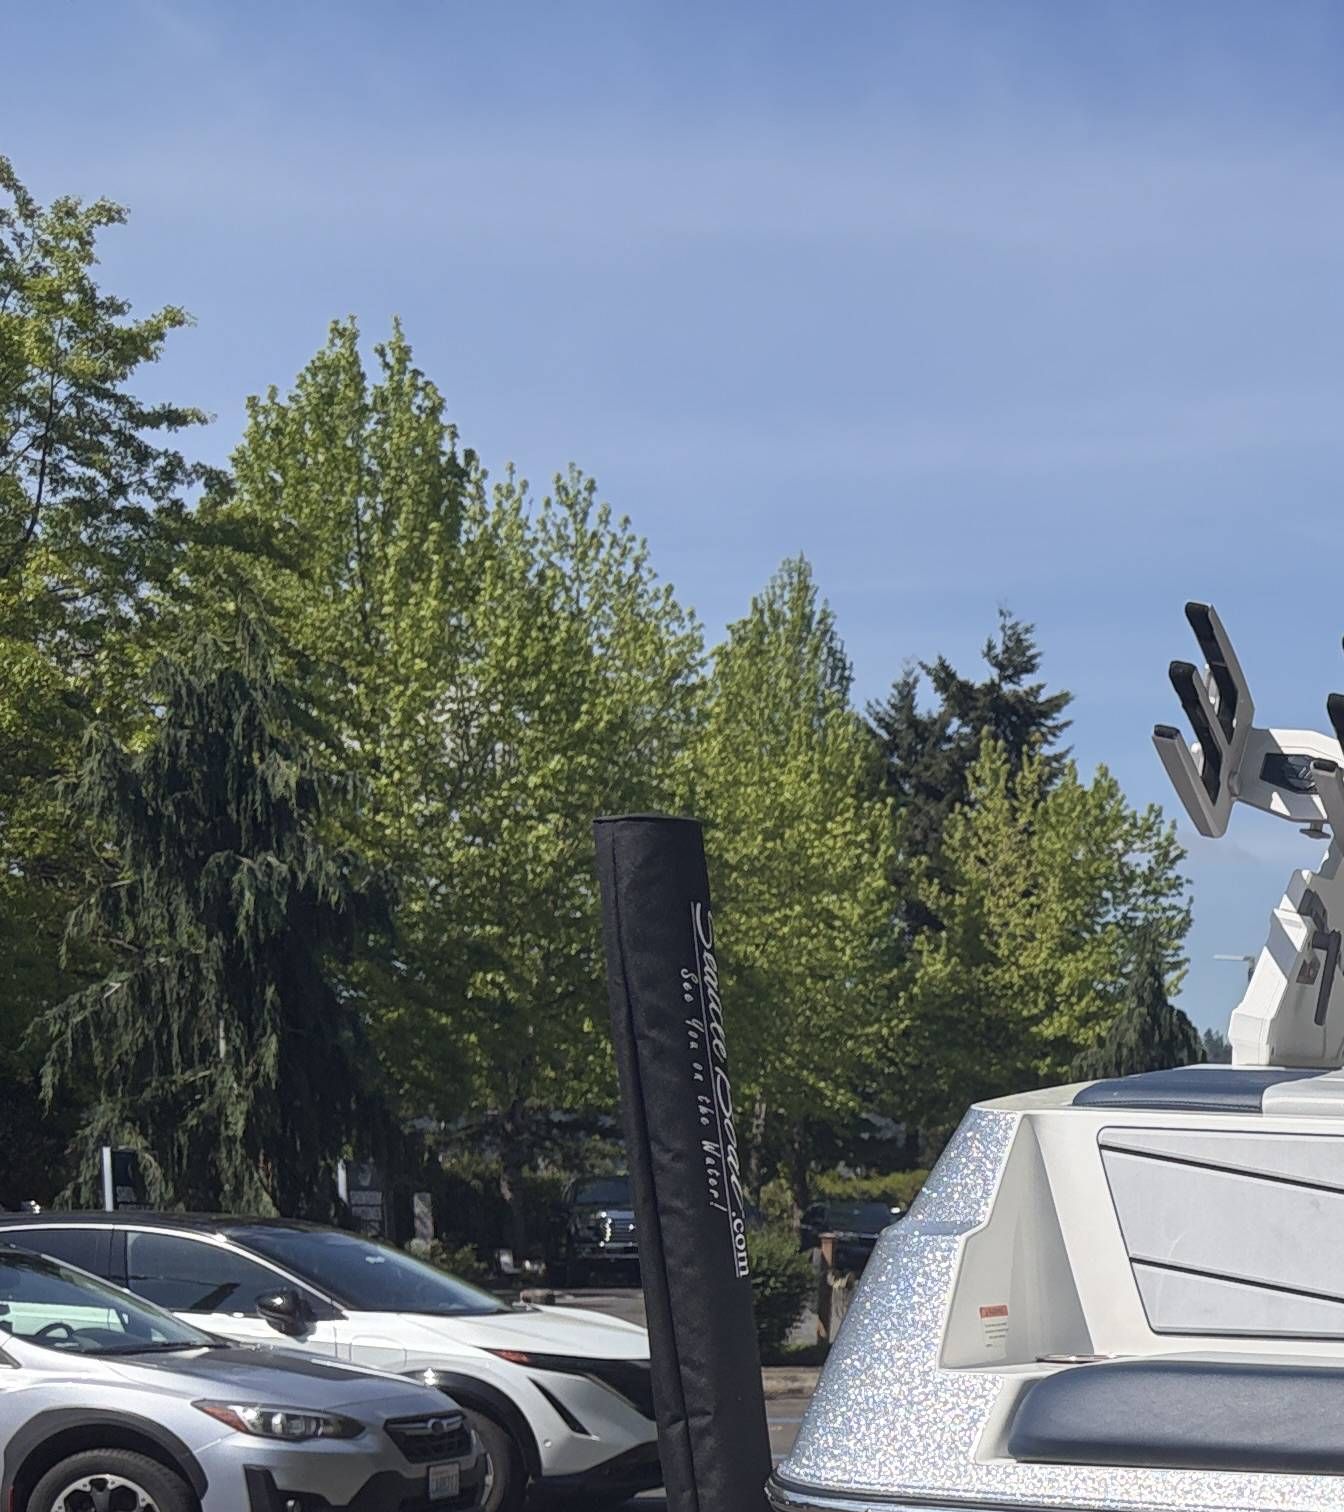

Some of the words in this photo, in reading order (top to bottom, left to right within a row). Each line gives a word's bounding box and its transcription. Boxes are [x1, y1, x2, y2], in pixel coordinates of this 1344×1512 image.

[681, 968, 699, 1002] See
[692, 1062, 704, 1082] on
[698, 1095, 714, 1125] the
